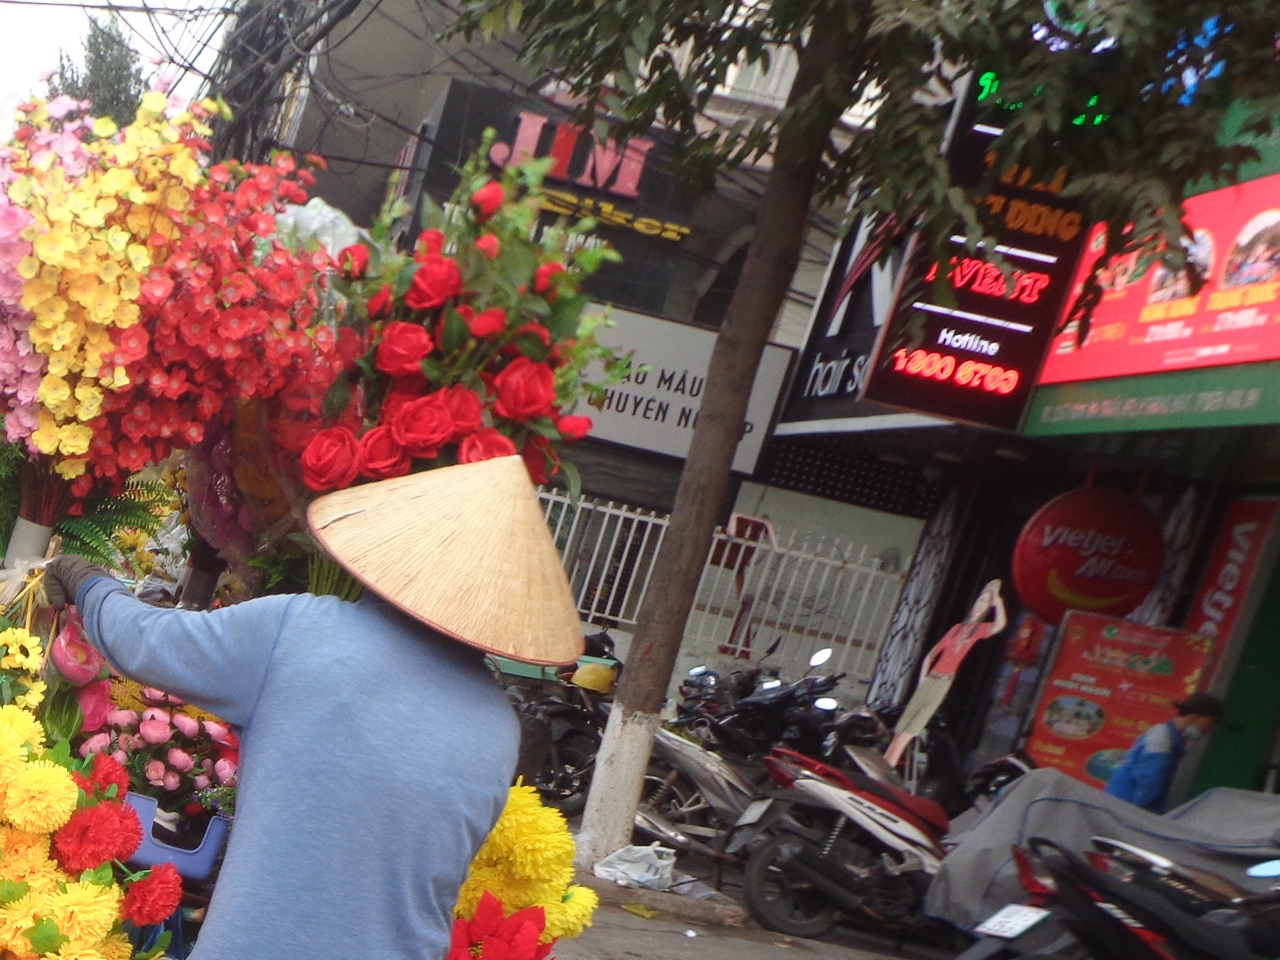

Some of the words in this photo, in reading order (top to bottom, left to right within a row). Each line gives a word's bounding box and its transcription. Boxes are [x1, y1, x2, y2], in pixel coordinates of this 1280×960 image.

[489, 111, 655, 198] JIM
[937, 328, 1001, 356] Hotline
[803, 348, 851, 398] hair
